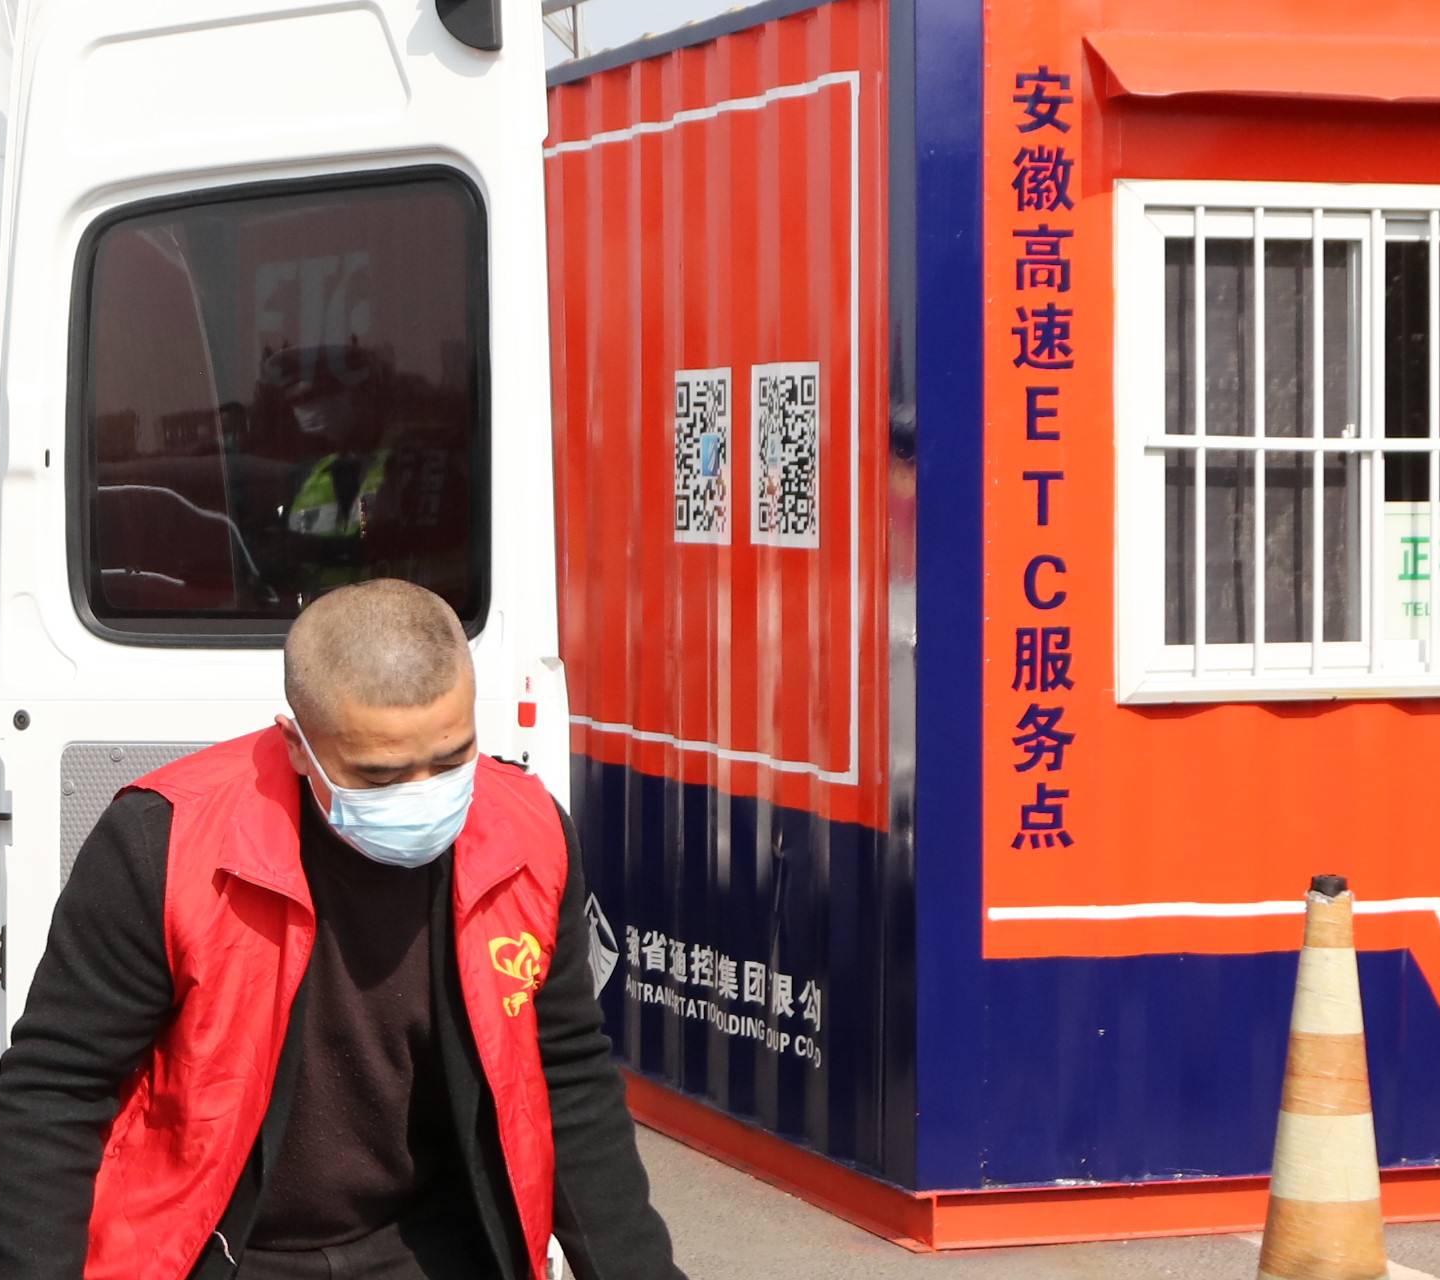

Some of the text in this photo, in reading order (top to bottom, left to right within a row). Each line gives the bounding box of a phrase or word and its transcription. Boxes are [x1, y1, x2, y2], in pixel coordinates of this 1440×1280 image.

[1011, 65, 1076, 850] 安徽高速ETC服务点
